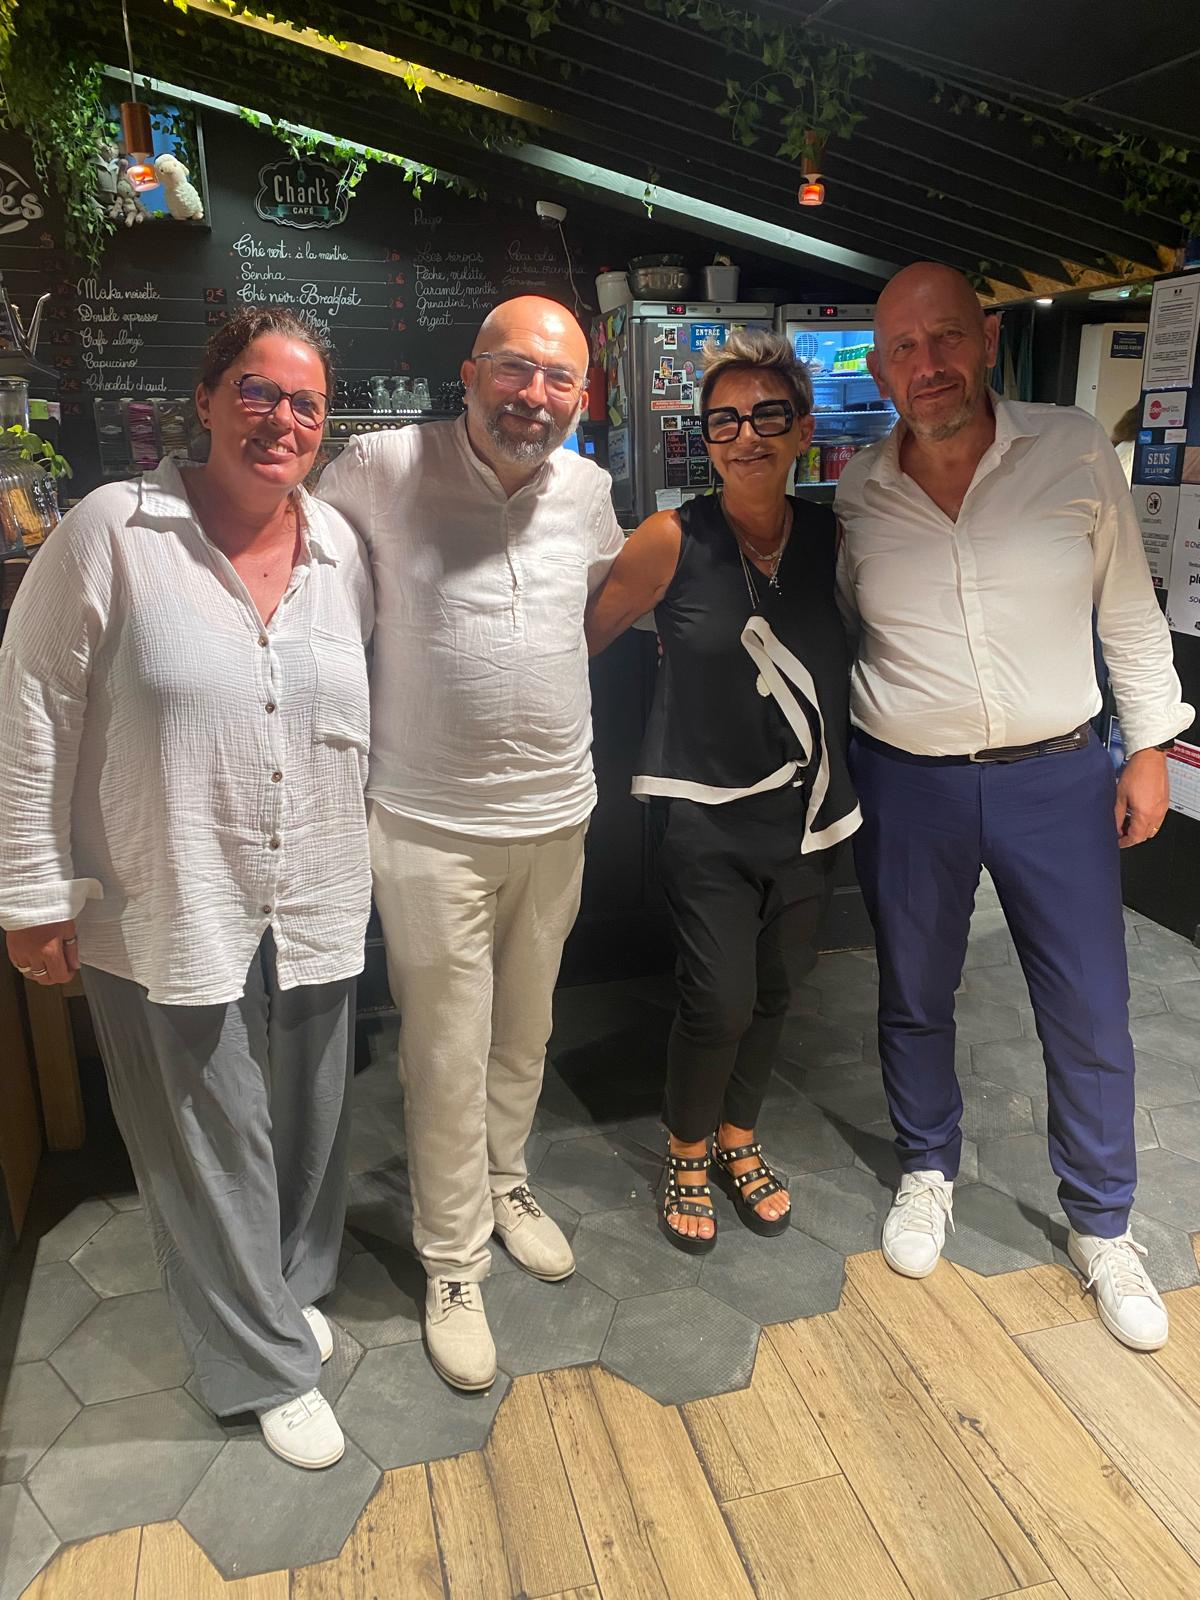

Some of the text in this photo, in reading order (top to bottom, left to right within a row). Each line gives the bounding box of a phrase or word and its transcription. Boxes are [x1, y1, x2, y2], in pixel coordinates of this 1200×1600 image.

[274, 174, 330, 205] Charl's
[292, 206, 314, 215] CAFÉ
[295, 246, 304, 259] à
[305, 241, 317, 259] la
[318, 244, 349, 260] menthe
[241, 262, 286, 281] Sencha
[77, 304, 120, 322] Double
[695, 328, 721, 337] ENTRÉE
[1147, 453, 1171, 465] SENS
